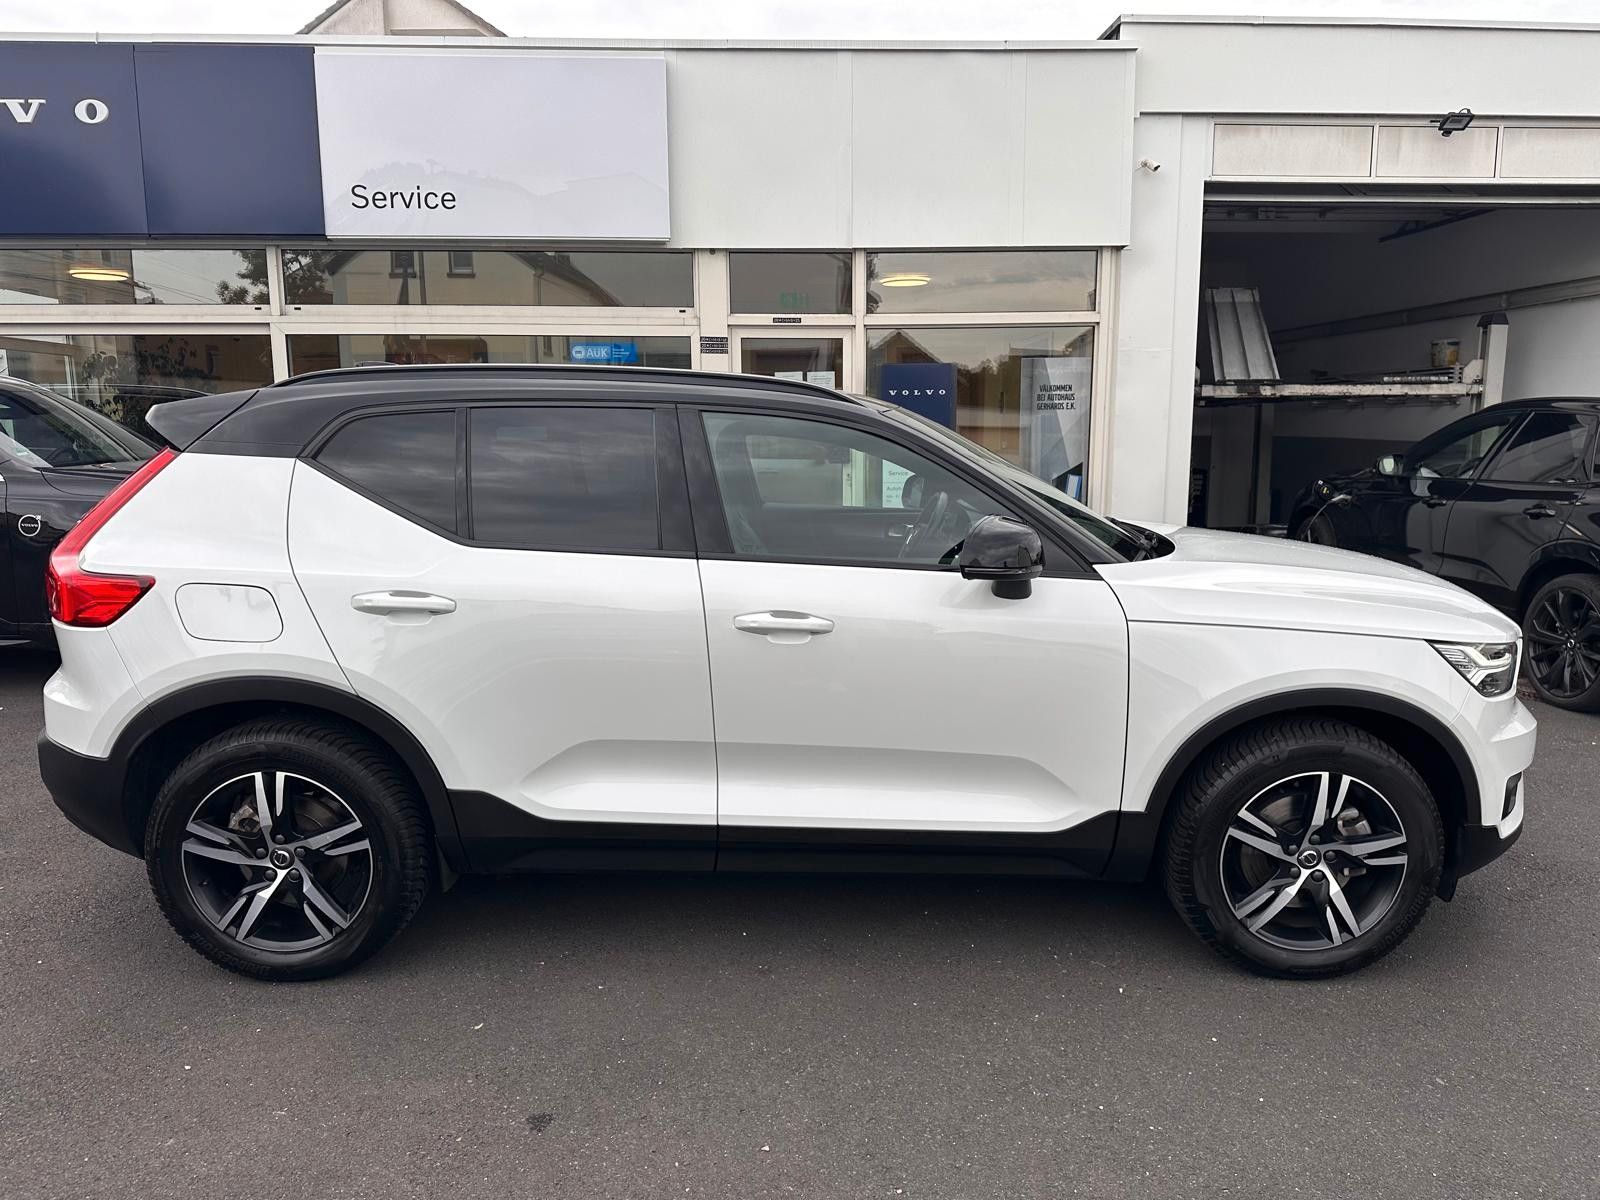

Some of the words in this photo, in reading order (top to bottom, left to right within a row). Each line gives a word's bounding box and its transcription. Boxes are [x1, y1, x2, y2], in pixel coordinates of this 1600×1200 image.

[351, 184, 456, 210] Service
[1036, 393, 1046, 401] BEI
[1047, 393, 1075, 401] AUTOHAUS
